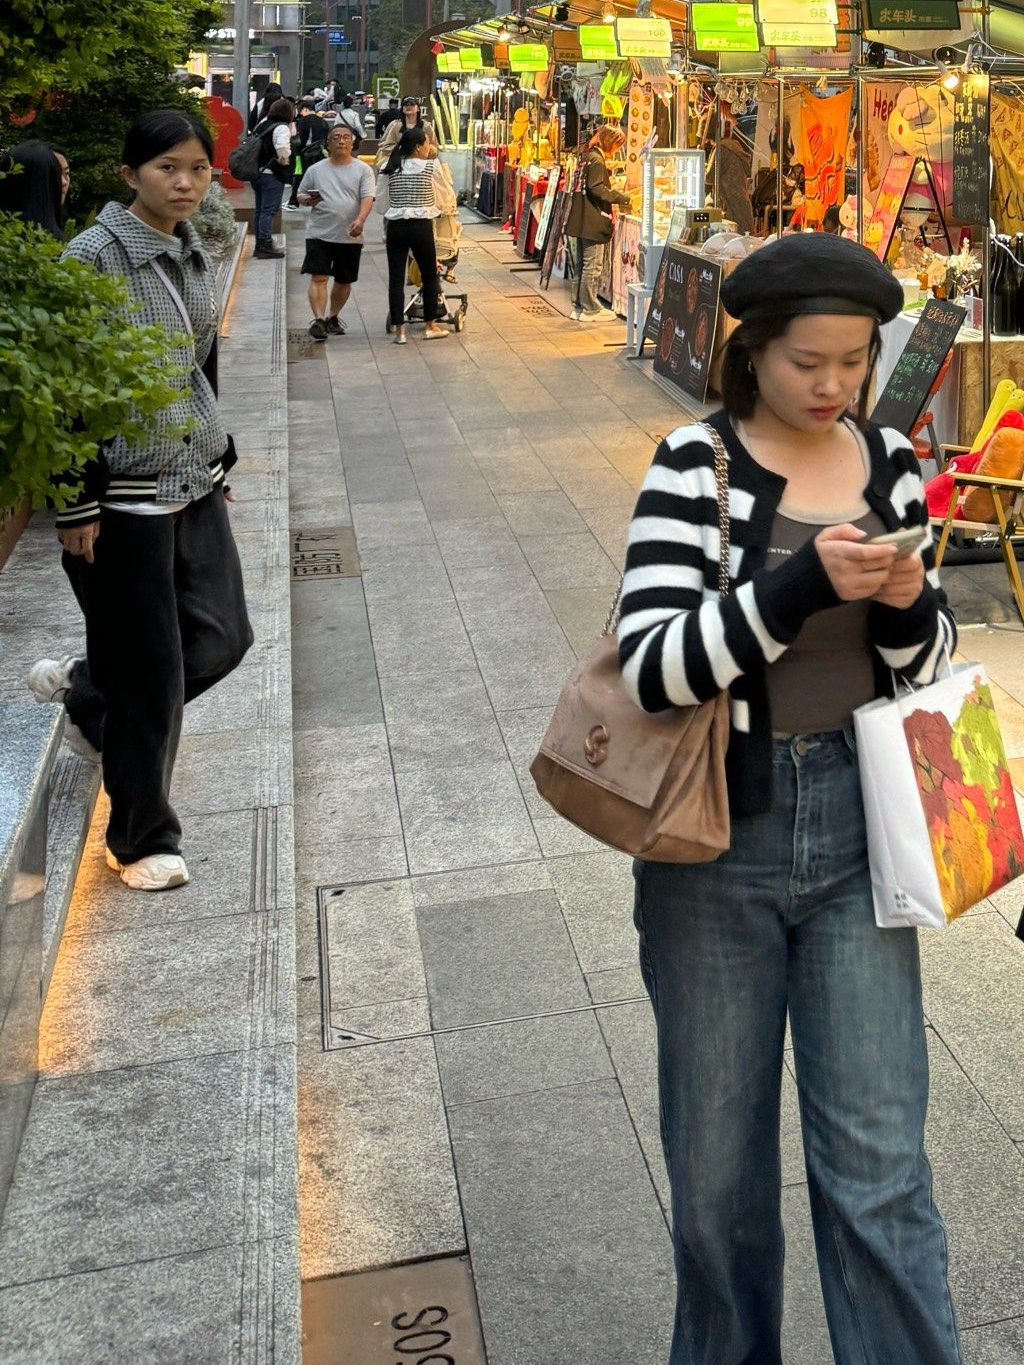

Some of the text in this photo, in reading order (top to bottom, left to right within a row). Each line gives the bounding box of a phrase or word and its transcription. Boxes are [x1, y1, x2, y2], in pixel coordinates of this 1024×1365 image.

[810, 8, 828, 19] 98
[880, 7, 916, 23] 火车头
